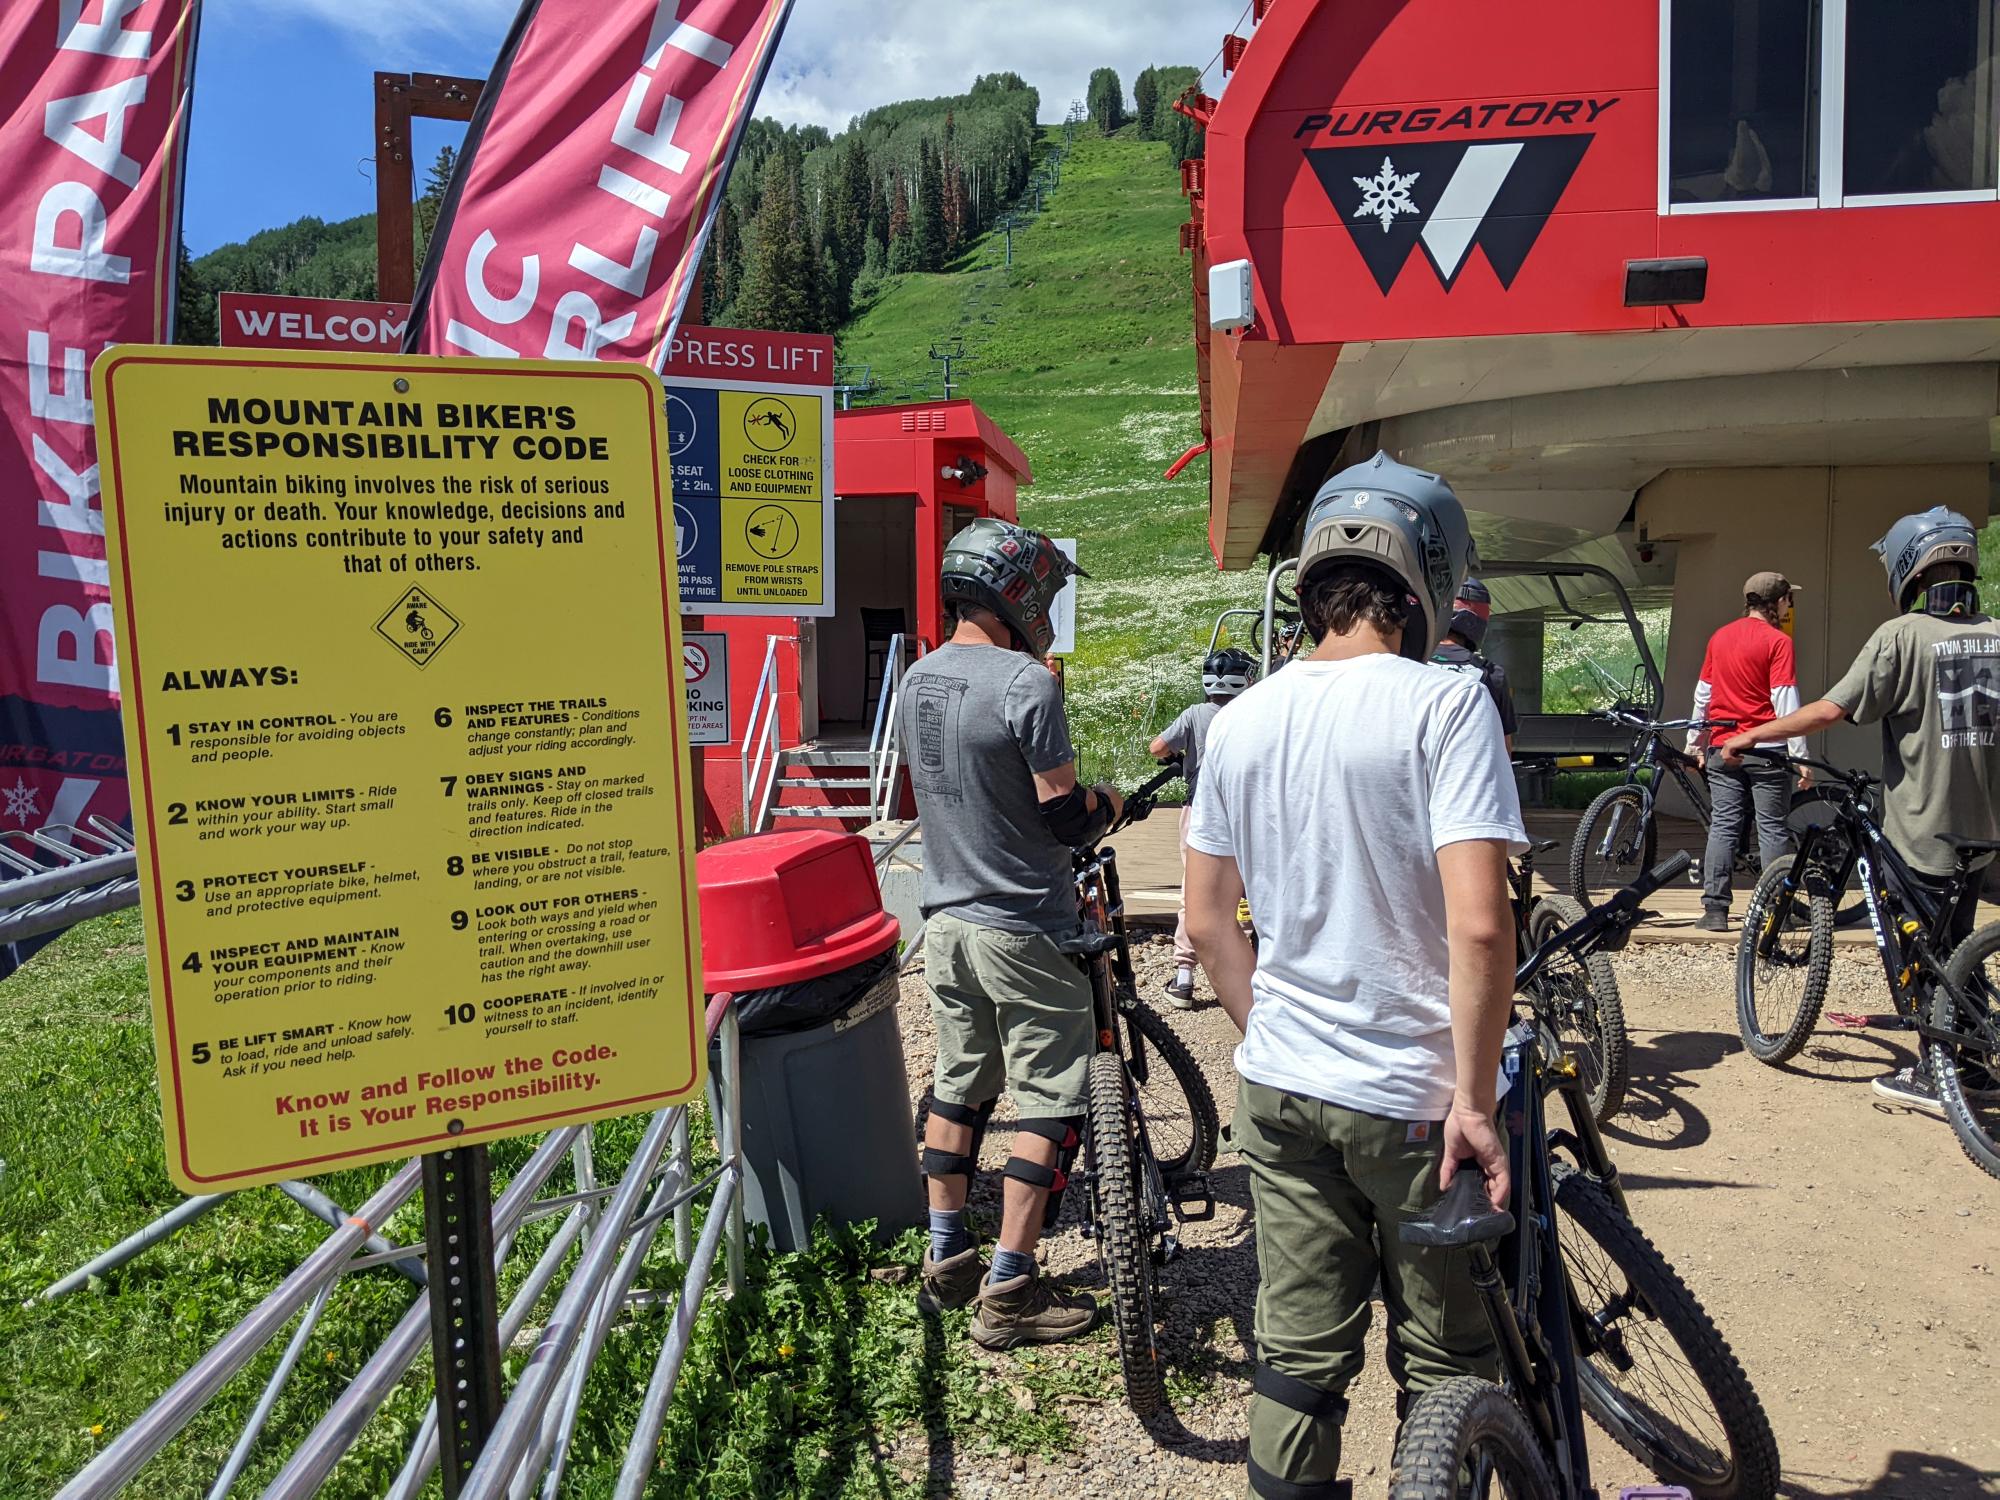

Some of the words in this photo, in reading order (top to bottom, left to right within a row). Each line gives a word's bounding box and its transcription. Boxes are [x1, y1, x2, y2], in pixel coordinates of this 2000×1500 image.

[1293, 97, 1621, 139] PURGATORY
[767, 345, 823, 371] LIFT
[207, 397, 423, 428] MOUNTAIN
[436, 403, 577, 431] BIKER'S
[172, 430, 501, 460] RESPONSIBILITY
[512, 435, 610, 461] CODE
[677, 465, 704, 477] SEAT
[743, 453, 777, 466] CHECK
[780, 455, 799, 466] FOR
[179, 473, 278, 495] Mountain
[285, 474, 347, 499] biking
[354, 474, 436, 495] involves
[441, 475, 473, 495] the
[479, 475, 515, 494] risk
[520, 475, 538, 494] of
[544, 475, 610, 495] serious
[693, 480, 713, 491] 2in.
[728, 467, 762, 480] LOOSE
[764, 469, 814, 481] CLOTHING
[730, 482, 753, 492] AND
[755, 483, 812, 495] EQUIPMENT
[164, 501, 226, 527] injury
[234, 505, 256, 522] or
[263, 501, 327, 522] death.
[333, 500, 378, 521] Your
[385, 500, 494, 524] knowledge,
[501, 500, 587, 520] decisions
[593, 500, 625, 519] and
[221, 528, 298, 549] actions
[305, 527, 407, 548] contribute
[412, 527, 432, 546] to
[438, 530, 481, 550] your
[487, 525, 545, 548] safety
[551, 525, 584, 544] and
[343, 553, 383, 574] that
[389, 553, 408, 573] of
[414, 552, 481, 572] others.
[725, 563, 761, 573] REMOVE
[763, 564, 785, 573] POLE
[786, 565, 819, 575] STRAPS
[691, 576, 713, 585] PASS
[697, 587, 717, 596] RIDE
[736, 587, 761, 597] UNTIL
[763, 588, 808, 598] UNLOADED
[744, 576, 766, 586] FROM
[769, 576, 803, 586] WRISTS
[412, 647, 429, 655] CARE
[1931, 640, 1962, 657] WALL
[1963, 638, 1982, 654] THE
[161, 665, 299, 692] ALWAYS:
[433, 706, 453, 729] 6
[464, 702, 525, 717] INSPECT
[527, 700, 556, 712] THE
[558, 697, 608, 711] TRAILS
[466, 717, 497, 730] AND
[500, 712, 570, 728] FEATURES
[581, 708, 640, 722] Conditions
[166, 723, 182, 747] 1
[188, 720, 232, 735] STAY
[236, 719, 255, 732] IN
[259, 714, 337, 730] CONTROL
[349, 712, 374, 724] You
[377, 712, 398, 723] are
[702, 722, 725, 730] AREAS
[0, 744, 126, 770] RGATO
[439, 775, 458, 798] 7
[465, 771, 505, 786] OBEY
[508, 767, 554, 782] SIGNS
[556, 765, 587, 778] AND
[466, 781, 545, 799] WARNINGS
[555, 779, 582, 792] Stay
[584, 779, 599, 789] on
[601, 772, 645, 787] marked
[195, 796, 246, 813] KNOW
[250, 793, 298, 807] YOUR
[302, 787, 356, 803] LIMITS
[368, 784, 398, 798] Ride
[167, 802, 189, 826] 2
[471, 852, 491, 865] BE
[493, 845, 551, 862] VISIBLE
[566, 843, 584, 854] Do
[586, 840, 606, 852] not
[607, 838, 634, 850] stop
[202, 870, 279, 889] PROTECT
[283, 861, 367, 881] YOURSELF
[446, 855, 465, 877] 8
[175, 879, 196, 903] 3
[475, 903, 516, 919] LOOK
[519, 899, 549, 913] OUT
[552, 895, 581, 909] FOR
[584, 888, 639, 905] OTHERS
[450, 909, 469, 931] 9
[209, 941, 281, 961] INSPECT
[285, 937, 319, 952] AND
[323, 926, 400, 947] MAINTAIN
[181, 951, 204, 974] 4
[211, 958, 260, 975] YOUR
[263, 945, 358, 969] EQUIPMENT
[370, 941, 406, 955] Know
[482, 988, 569, 1011] COOPERATE
[579, 984, 588, 996] If
[589, 977, 637, 995] involved
[639, 976, 650, 987] in
[652, 975, 665, 985] or
[443, 1002, 476, 1026] 10
[218, 1037, 240, 1051] BE
[243, 1031, 277, 1047] LIFT
[281, 1023, 335, 1041] SMART
[347, 1018, 383, 1032] Know
[385, 1013, 412, 1026] how
[191, 1041, 212, 1065] 5
[275, 1089, 351, 1116] Know
[360, 1075, 408, 1102] and
[417, 1064, 496, 1092] Follow
[503, 1056, 544, 1076] the
[551, 1043, 618, 1068] Code.
[1934, 1043, 1952, 1102] MAXXIS
[299, 1118, 320, 1138] It
[328, 1113, 352, 1133] is
[359, 1103, 417, 1127] Your
[425, 1071, 601, 1116] Responsibility.
